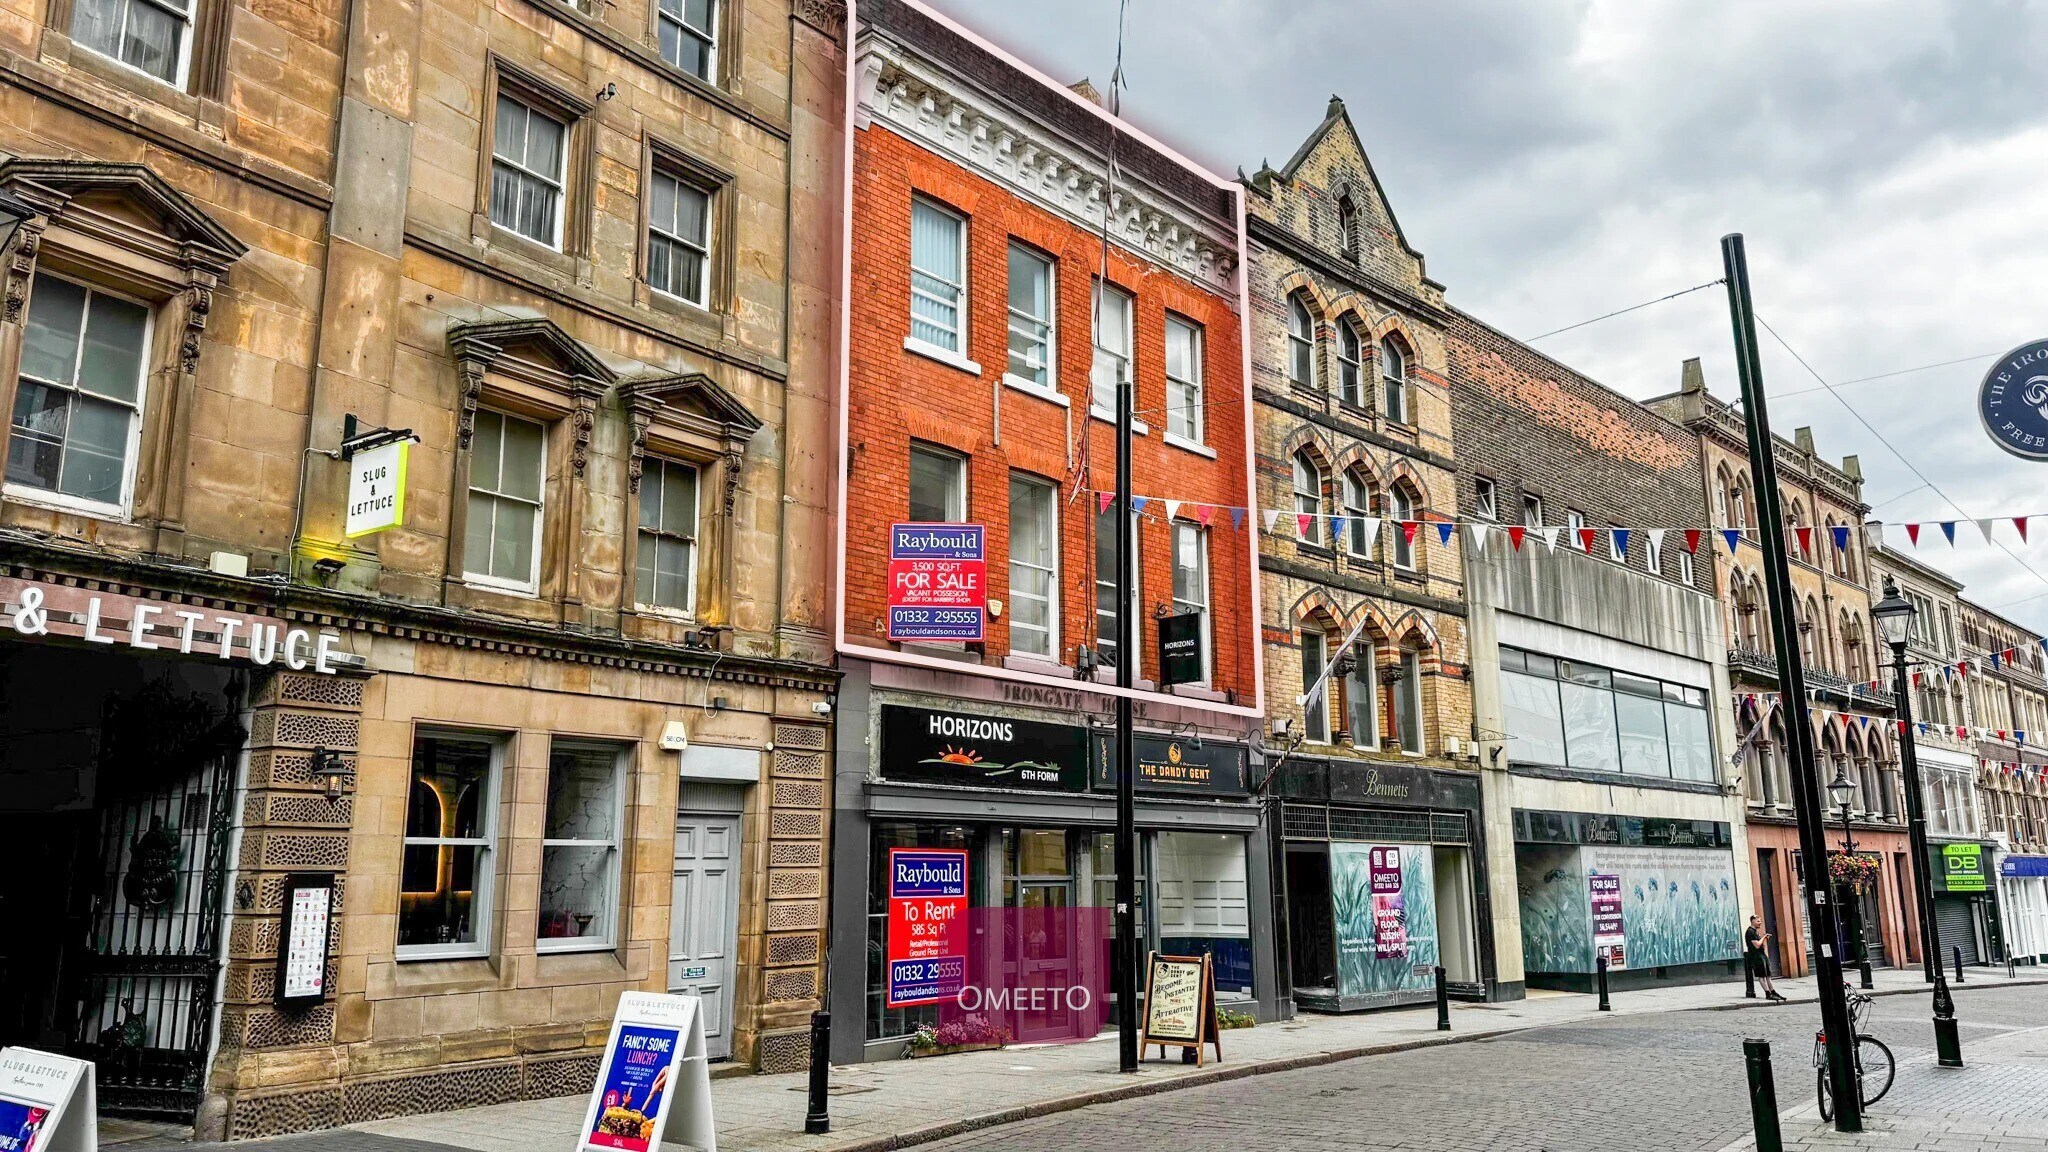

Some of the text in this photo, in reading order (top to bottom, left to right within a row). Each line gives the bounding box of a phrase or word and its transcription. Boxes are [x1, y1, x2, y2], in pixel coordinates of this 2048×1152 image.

[1990, 371, 2011, 408] THE
[2001, 420, 2046, 447] FREE
[362, 466, 387, 483] SLUG
[370, 484, 376, 496] &
[351, 495, 393, 516] LETTUCE
[897, 532, 978, 551] Raybould
[896, 573, 978, 589] FOR SALE
[895, 611, 978, 624] 01332 295555
[13, 587, 340, 675] & LETTUCE
[894, 627, 977, 637] raybouldandsons.co.uk
[1164, 640, 1195, 650] HORIZONS
[1003, 683, 1084, 711] IRONGATE
[929, 714, 1014, 741] HORIZONS
[1021, 770, 1059, 782] 6TH FORM
[1139, 764, 1211, 780] THE DANDY GENT
[1361, 769, 1409, 798] Bennetts
[1587, 818, 1618, 842] Bennetts
[1669, 823, 1695, 845] Bennetts
[896, 863, 962, 887] Raybould
[1374, 873, 1399, 883] OMEETO
[949, 886, 962, 894] Sons
[1592, 880, 1617, 889] FOR SALE
[903, 901, 957, 922] To Rent
[1378, 909, 1401, 917] GROUND
[912, 923, 947, 937] 585 Sq Ft
[1381, 920, 1399, 929] FLOOR
[909, 949, 927, 957] Ground
[927, 948, 939, 956] Floor
[1377, 943, 1391, 952] WILL
[1391, 942, 1406, 951] SPLIT
[894, 961, 962, 982] 01332 295555
[894, 984, 961, 1000] raybouldandsons.co.uk
[1154, 979, 1183, 994] BECOME
[1163, 986, 1196, 1000] INSTANTLY
[1154, 1006, 1194, 1020] ATTRACTIVE
[622, 1034, 671, 1053] FANCY SOME
[626, 1050, 658, 1066] LUNCH?
